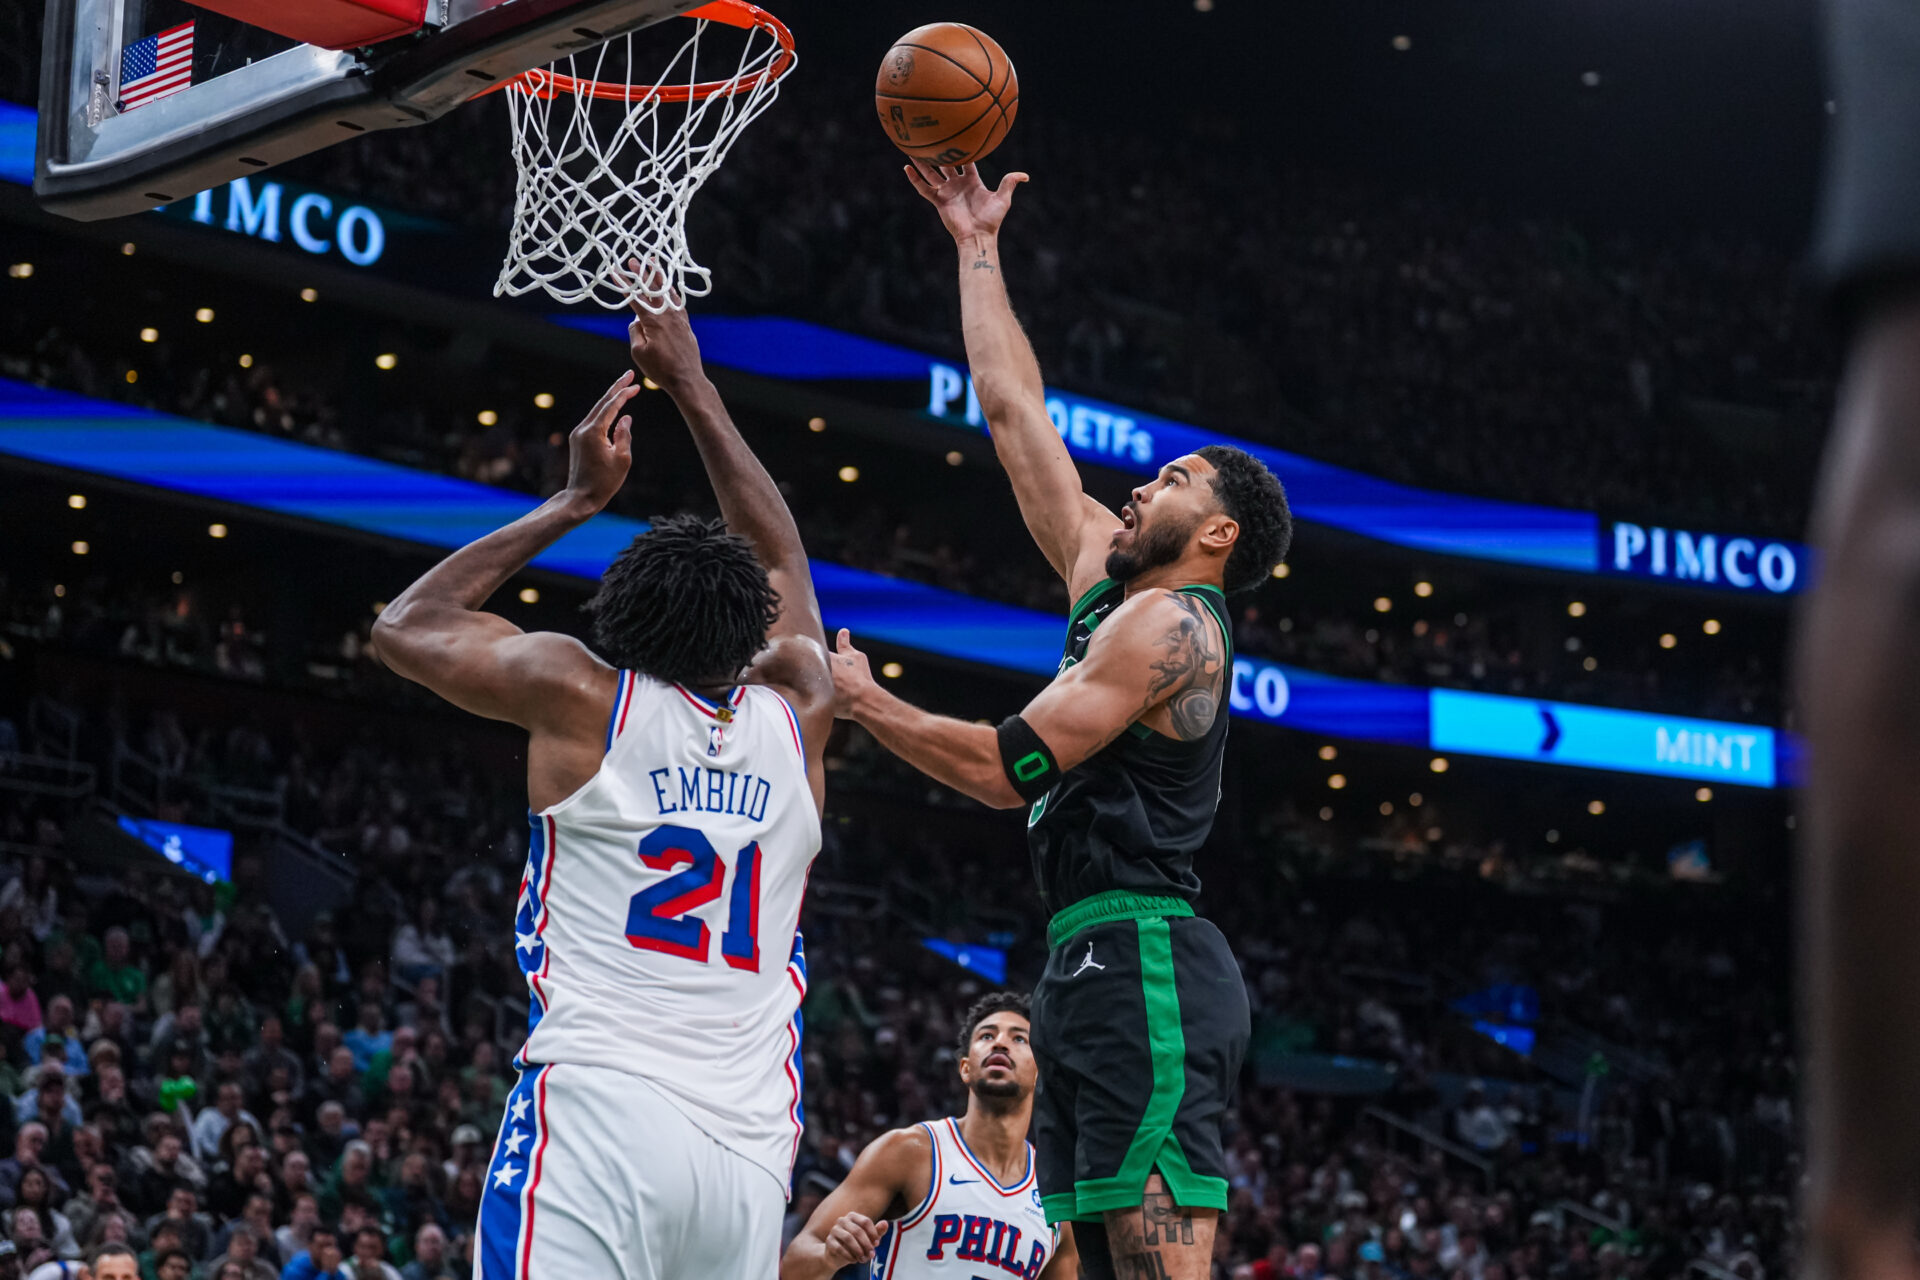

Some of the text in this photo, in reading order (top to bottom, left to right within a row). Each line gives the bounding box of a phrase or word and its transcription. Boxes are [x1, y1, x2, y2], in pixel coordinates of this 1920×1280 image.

[154, 176, 386, 267] IMCO
[1613, 521, 1797, 593] PIMCO
[1229, 654, 1290, 718] CO
[1656, 726, 1756, 772] MINT
[649, 766, 771, 823] EMBIID
[625, 823, 763, 974] 21
